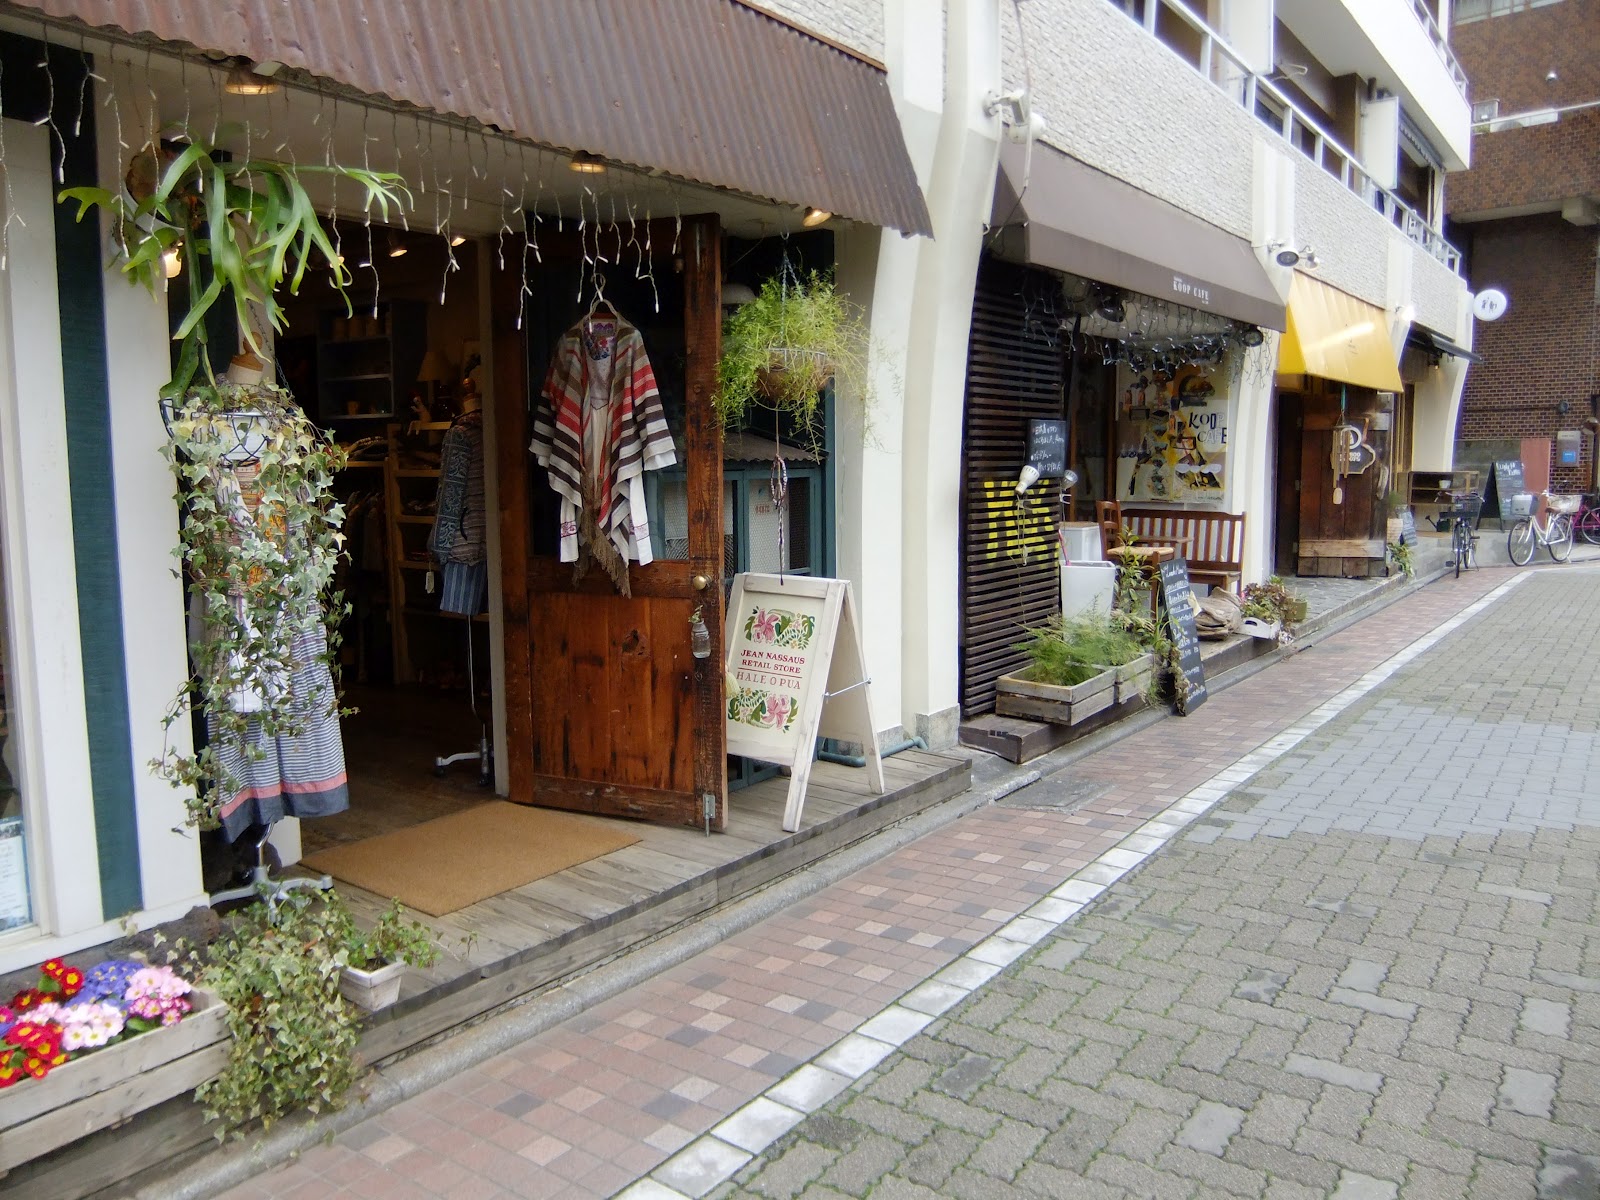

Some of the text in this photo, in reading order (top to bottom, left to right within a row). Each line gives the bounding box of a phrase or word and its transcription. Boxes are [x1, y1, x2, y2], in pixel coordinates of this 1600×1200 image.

[1173, 280, 1209, 300] KOOP CAFE
[1189, 411, 1225, 429] KOOP
[1197, 427, 1227, 444] CAFE
[740, 649, 805, 664] JEAN NASSAUS
[741, 659, 801, 674] RETAIL STORE
[736, 671, 801, 689] HALE O PUA
